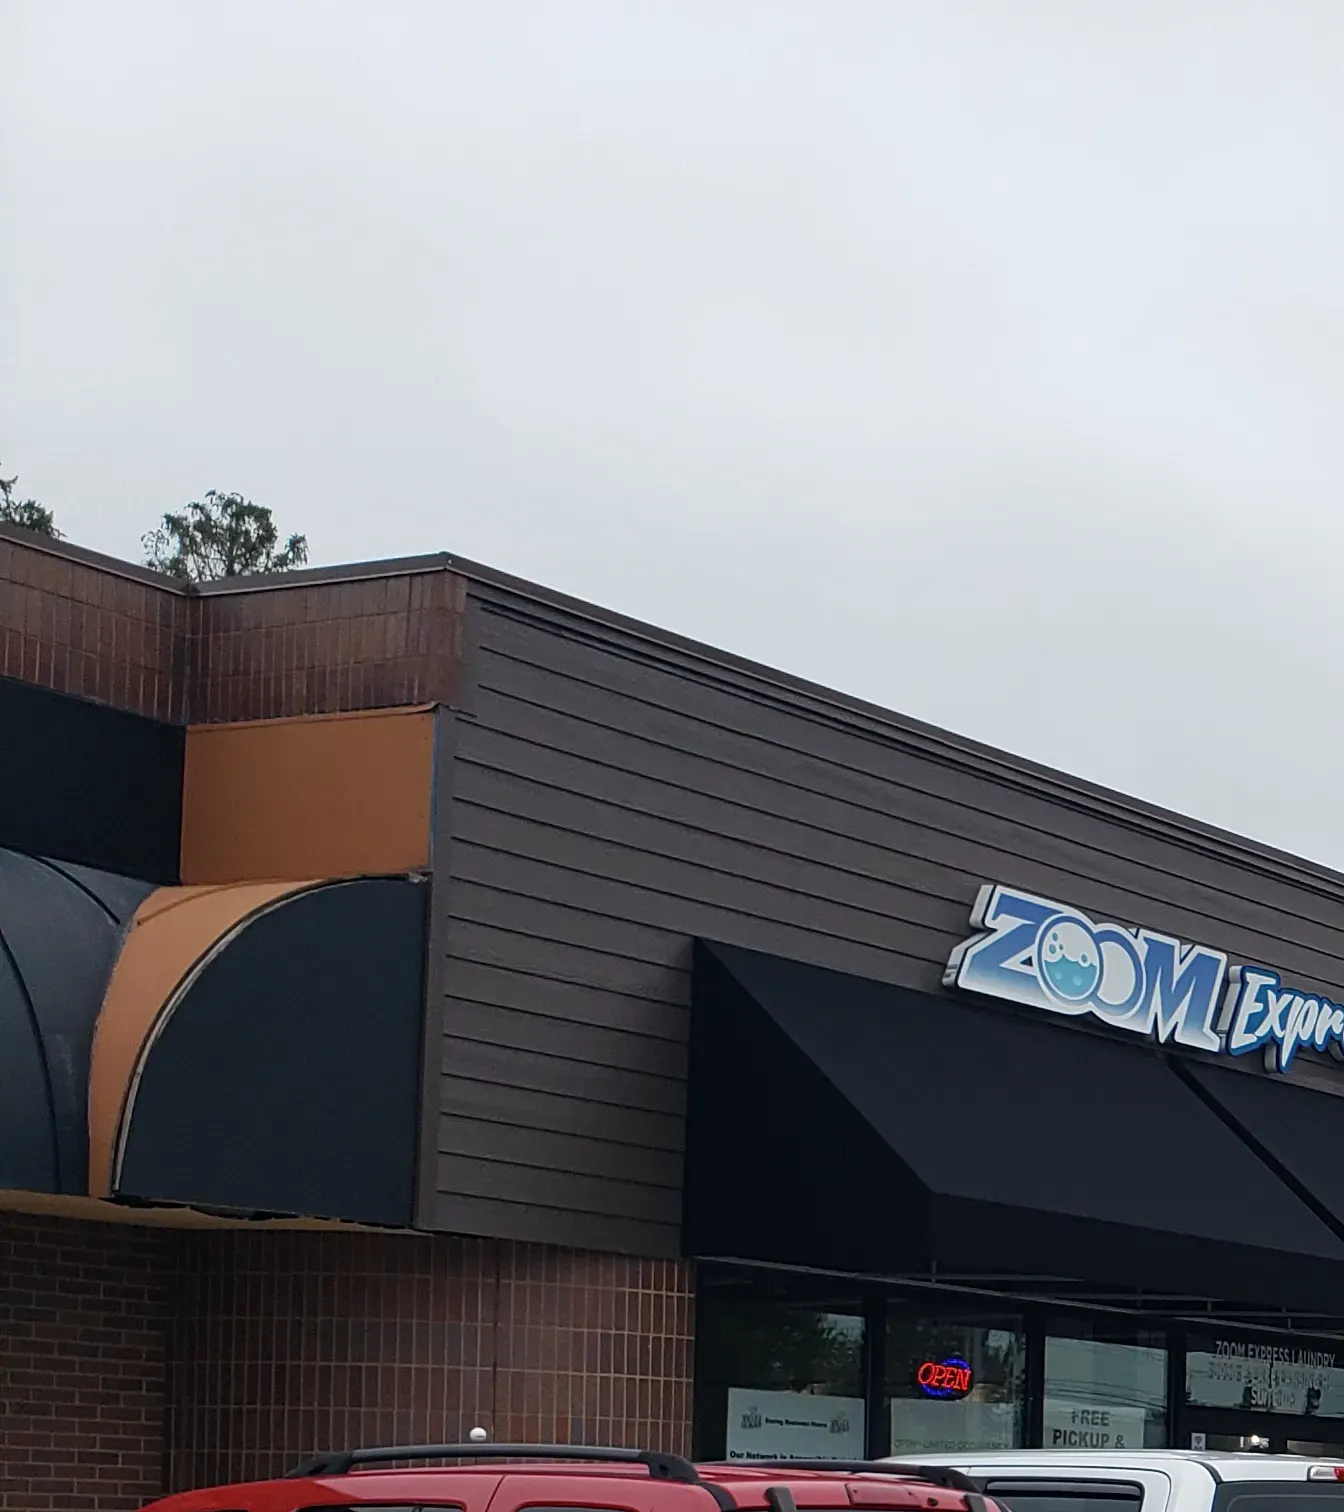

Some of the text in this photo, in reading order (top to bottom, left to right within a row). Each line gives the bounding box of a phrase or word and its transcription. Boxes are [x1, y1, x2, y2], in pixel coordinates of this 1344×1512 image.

[954, 885, 1228, 1053] ZOOM
[1215, 1340, 1336, 1368] ZOOM EXPRESS LAUNDRY
[918, 1362, 971, 1391] OPEN
[1071, 1408, 1111, 1427] FREE
[1052, 1429, 1126, 1448] PICKUP &
